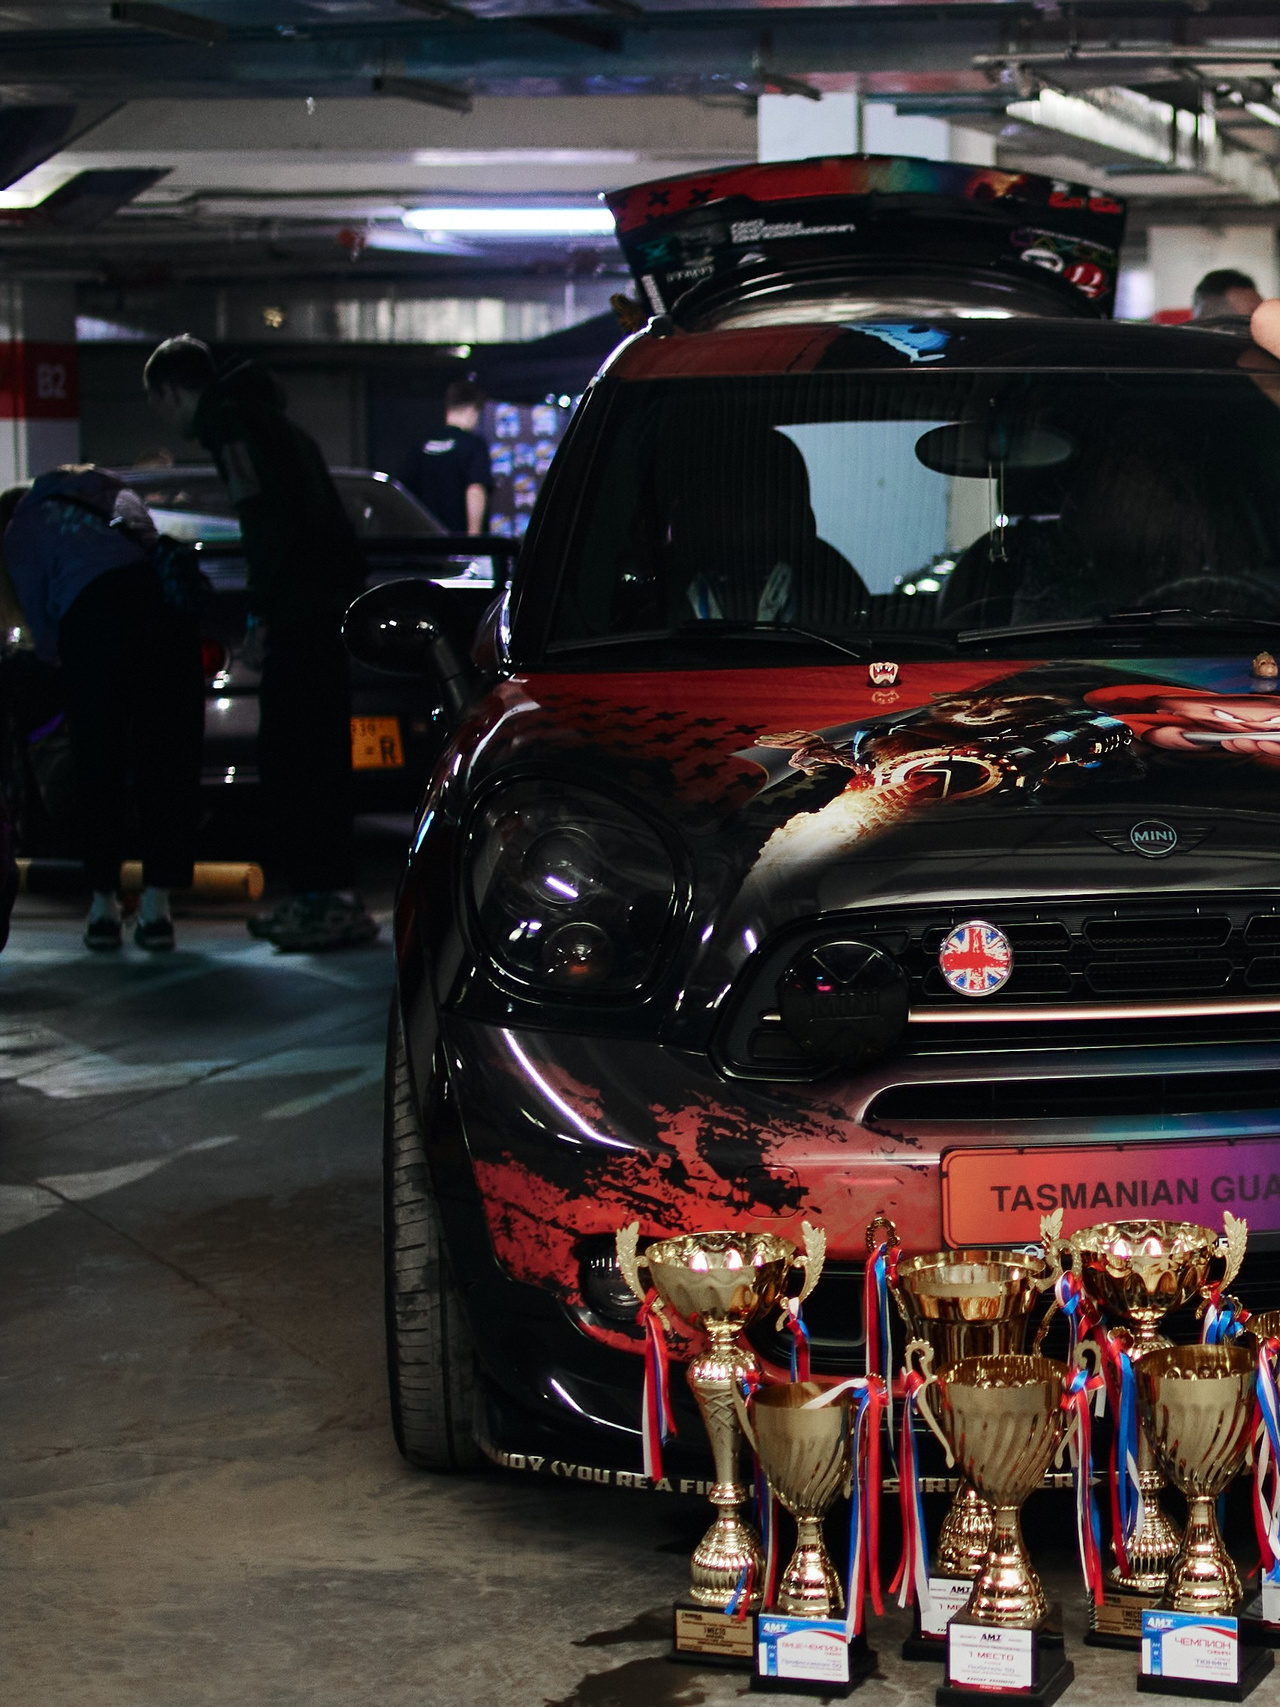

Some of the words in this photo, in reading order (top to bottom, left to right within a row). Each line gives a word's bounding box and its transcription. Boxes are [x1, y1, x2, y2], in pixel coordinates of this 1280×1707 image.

[1134, 831, 1173, 841] MINI
[990, 1176, 1199, 1212] TASMANIAN
[1174, 1637, 1231, 1649] ЧЕМПИОН
[977, 1652, 1014, 1661] МЕСТО
